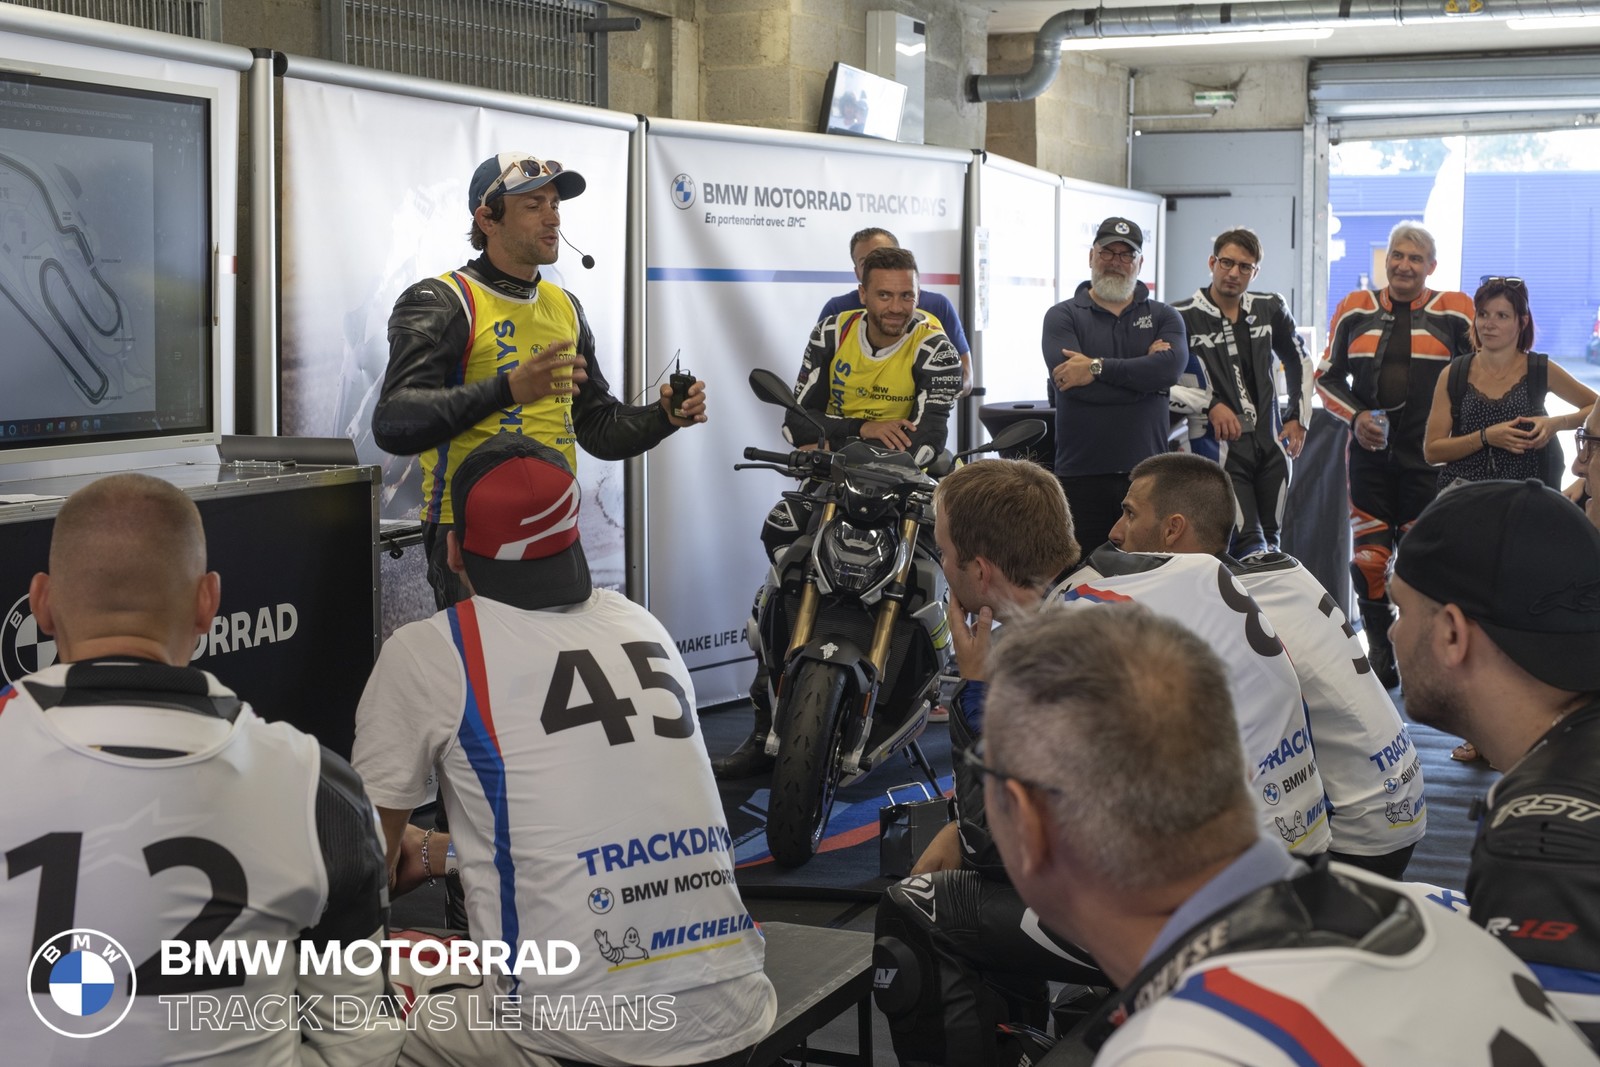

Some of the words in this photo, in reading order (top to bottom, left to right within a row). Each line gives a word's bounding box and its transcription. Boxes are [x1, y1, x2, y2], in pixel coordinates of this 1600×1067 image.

[703, 182, 749, 206] BMW
[754, 186, 852, 212] MOTORRAD
[856, 193, 908, 215] TRACK
[911, 196, 947, 218] DAYS
[705, 212, 717, 225] En
[718, 214, 765, 228] partenariat
[766, 218, 785, 228] avec
[714, 630, 738, 648] LIFE
[540, 640, 695, 746] 45
[1282, 767, 1308, 794] BMW
[621, 878, 669, 905] BMW
[5, 831, 249, 997] 12
[1486, 916, 1578, 941] R-18
